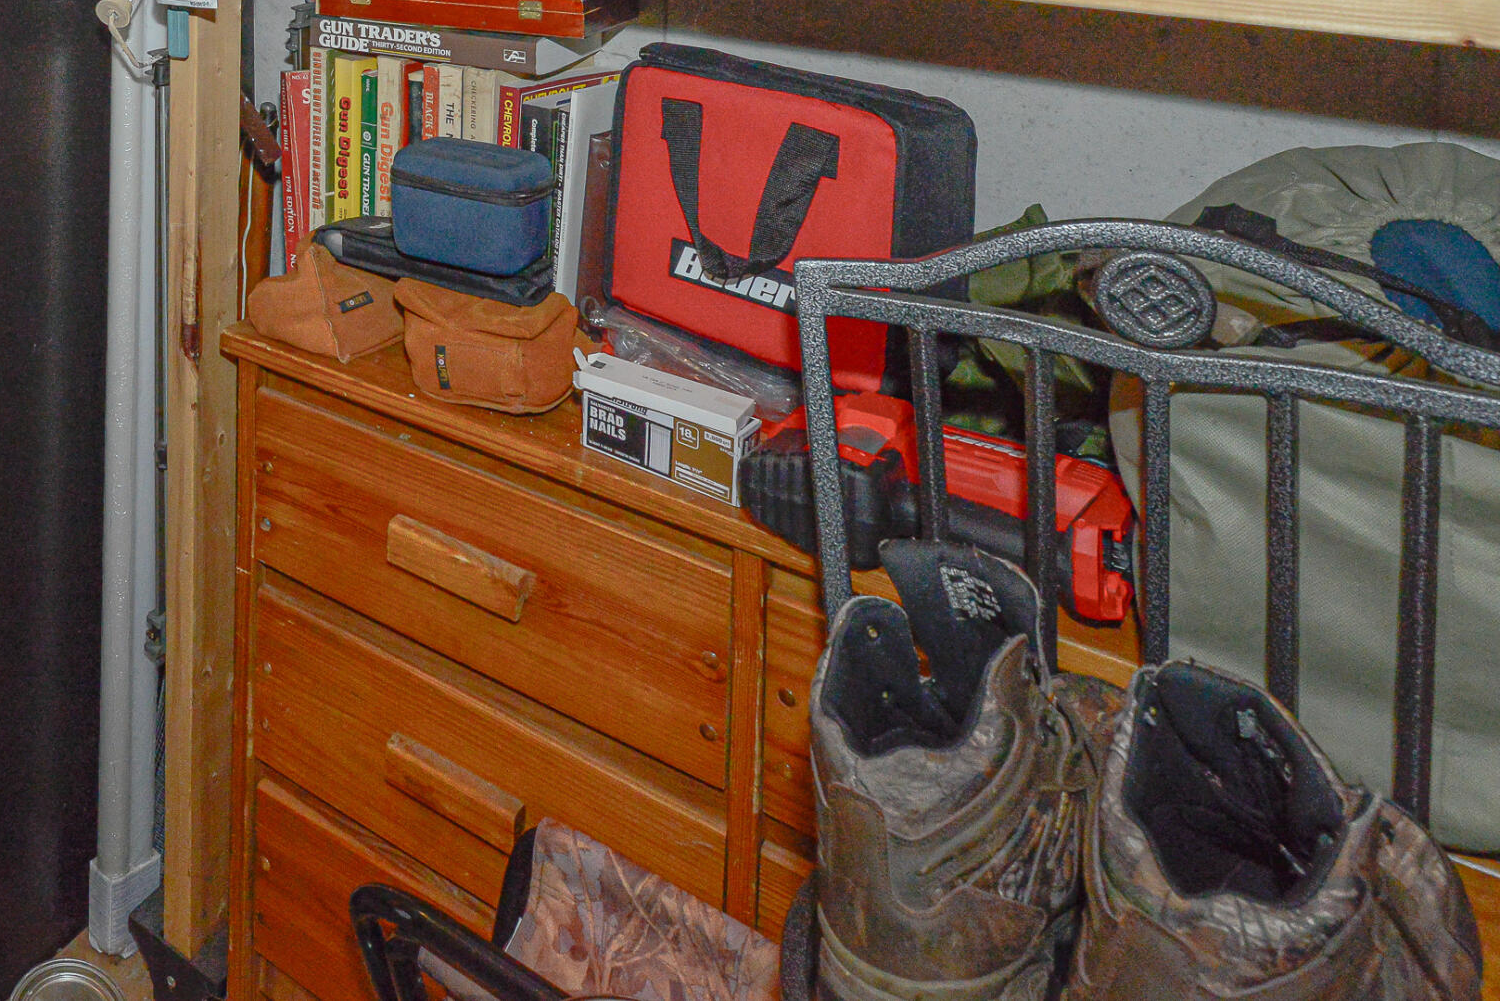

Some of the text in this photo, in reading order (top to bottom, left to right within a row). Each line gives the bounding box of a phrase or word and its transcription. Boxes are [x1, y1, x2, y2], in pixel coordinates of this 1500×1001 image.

[318, 18, 442, 48] GUN TRADER'S
[318, 33, 451, 58] GUIDE THIRTY-SECOND EDITION
[423, 91, 433, 132] BLACK
[445, 102, 456, 125] THE
[464, 79, 476, 131] CHECKERING
[311, 51, 322, 210] SINGLE SHOT RIFLES AND ACTIONS
[337, 96, 351, 200] Gun Digest
[530, 118, 539, 153] Complete
[362, 153, 371, 176] GUN
[379, 101, 394, 203] Gun Digest
[286, 195, 295, 233] EDITION
[589, 405, 624, 428] BRAD
[589, 417, 627, 442] NAILS
